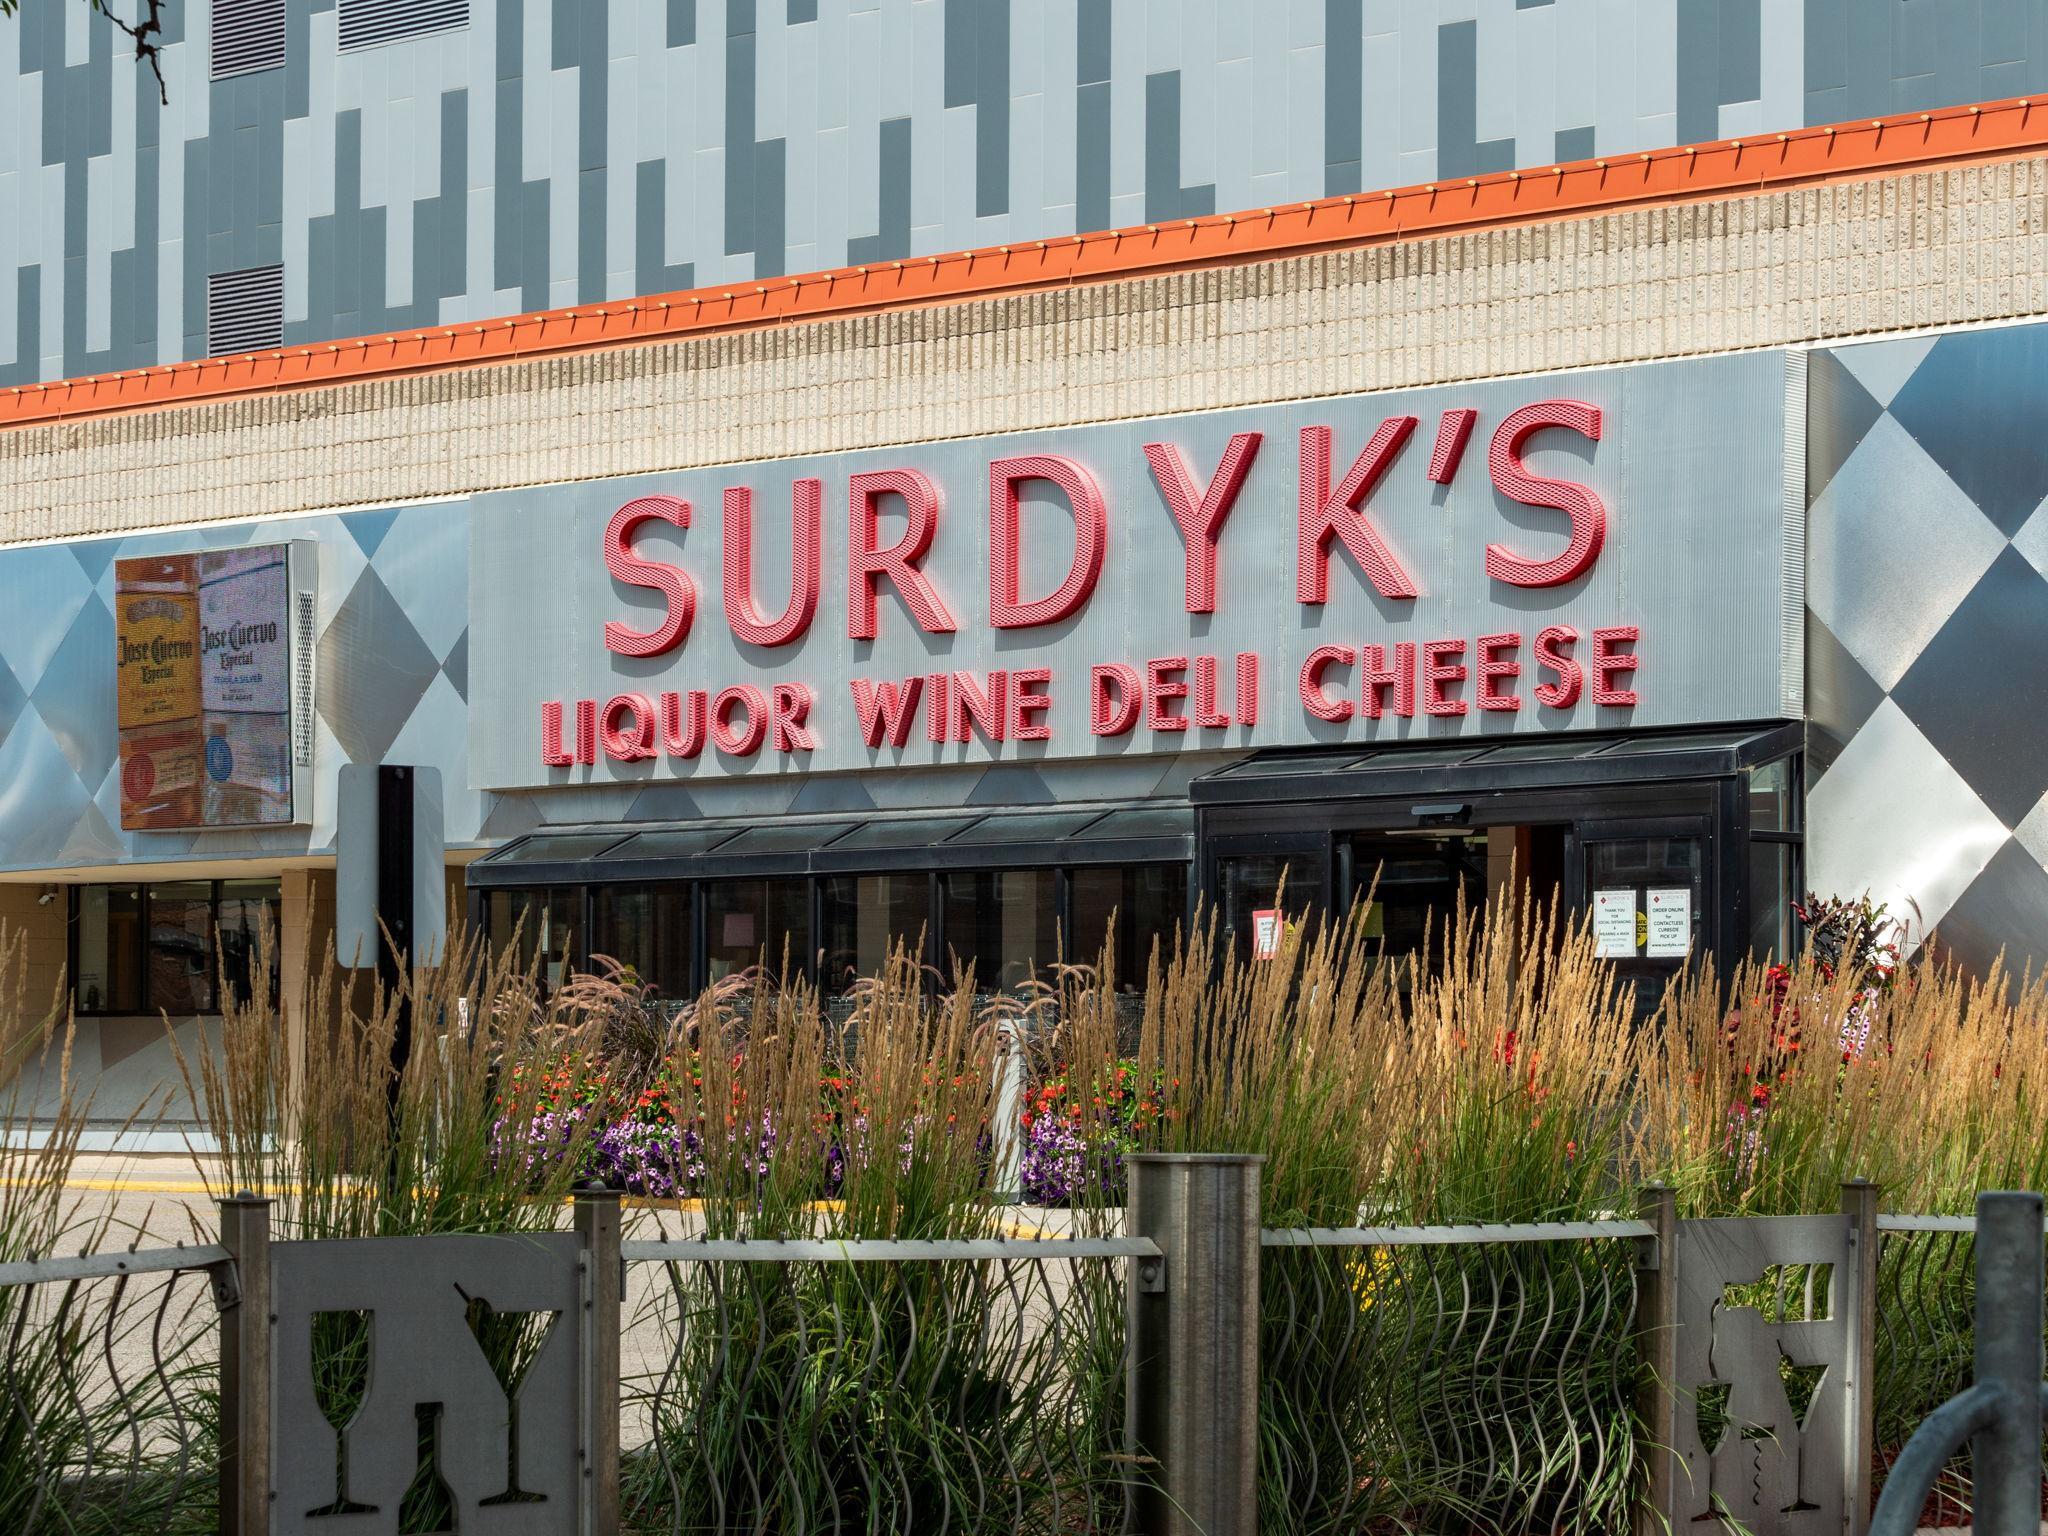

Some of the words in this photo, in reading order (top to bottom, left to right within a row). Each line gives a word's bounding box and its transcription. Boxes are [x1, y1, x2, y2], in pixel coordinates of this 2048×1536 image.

[603, 398, 1606, 659] SURDYK'S
[118, 635, 149, 668] Jose
[151, 634, 193, 665] Cuervo
[202, 626, 228, 655] Jose
[228, 620, 277, 652] Cuervo
[220, 649, 254, 671] Especial
[542, 681, 815, 768] LIQUOR
[849, 667, 1052, 750] WINE
[1091, 652, 1259, 737] DELI
[1300, 624, 1641, 724] CHEESE
